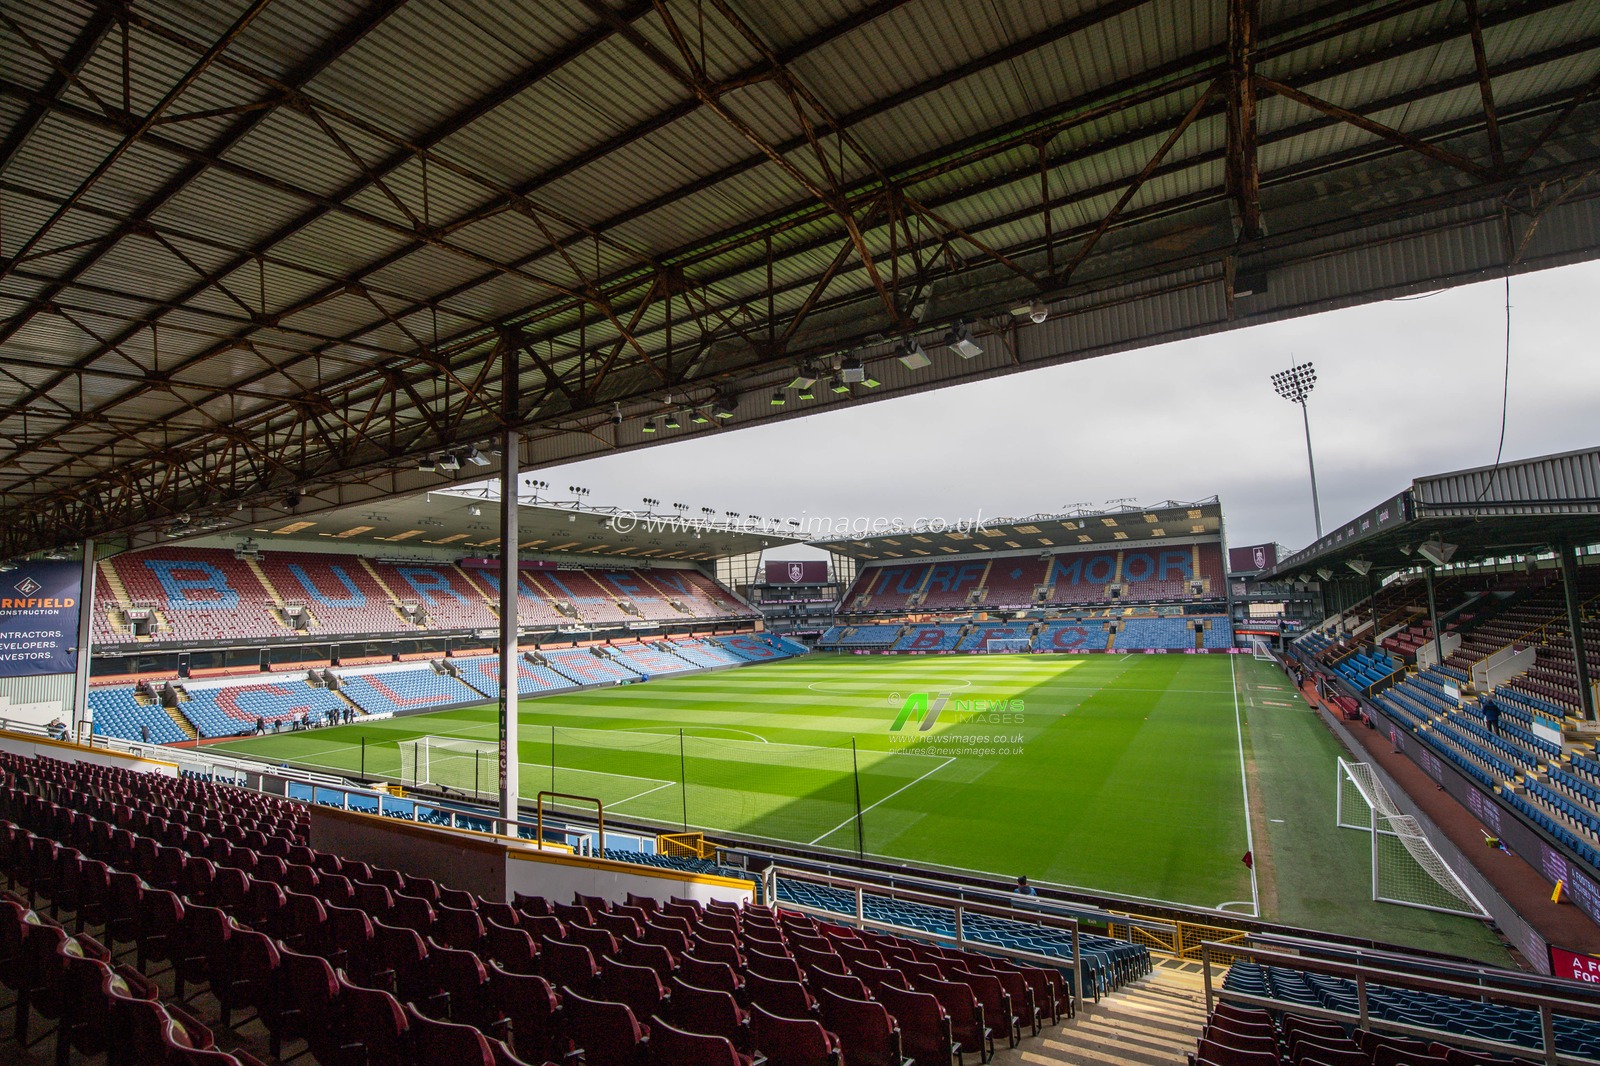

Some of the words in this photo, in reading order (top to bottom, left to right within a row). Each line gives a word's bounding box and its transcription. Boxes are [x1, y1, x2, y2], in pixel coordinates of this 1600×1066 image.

[144, 560, 697, 611] BURNLEY
[876, 563, 988, 596] TURF
[1049, 550, 1194, 587] MOOR
[1, 598, 75, 609] RNFIELD
[0, 630, 64, 639] NTRACTORS.
[214, 638, 775, 724] CLARETS
[1572, 957, 1583, 969] A
